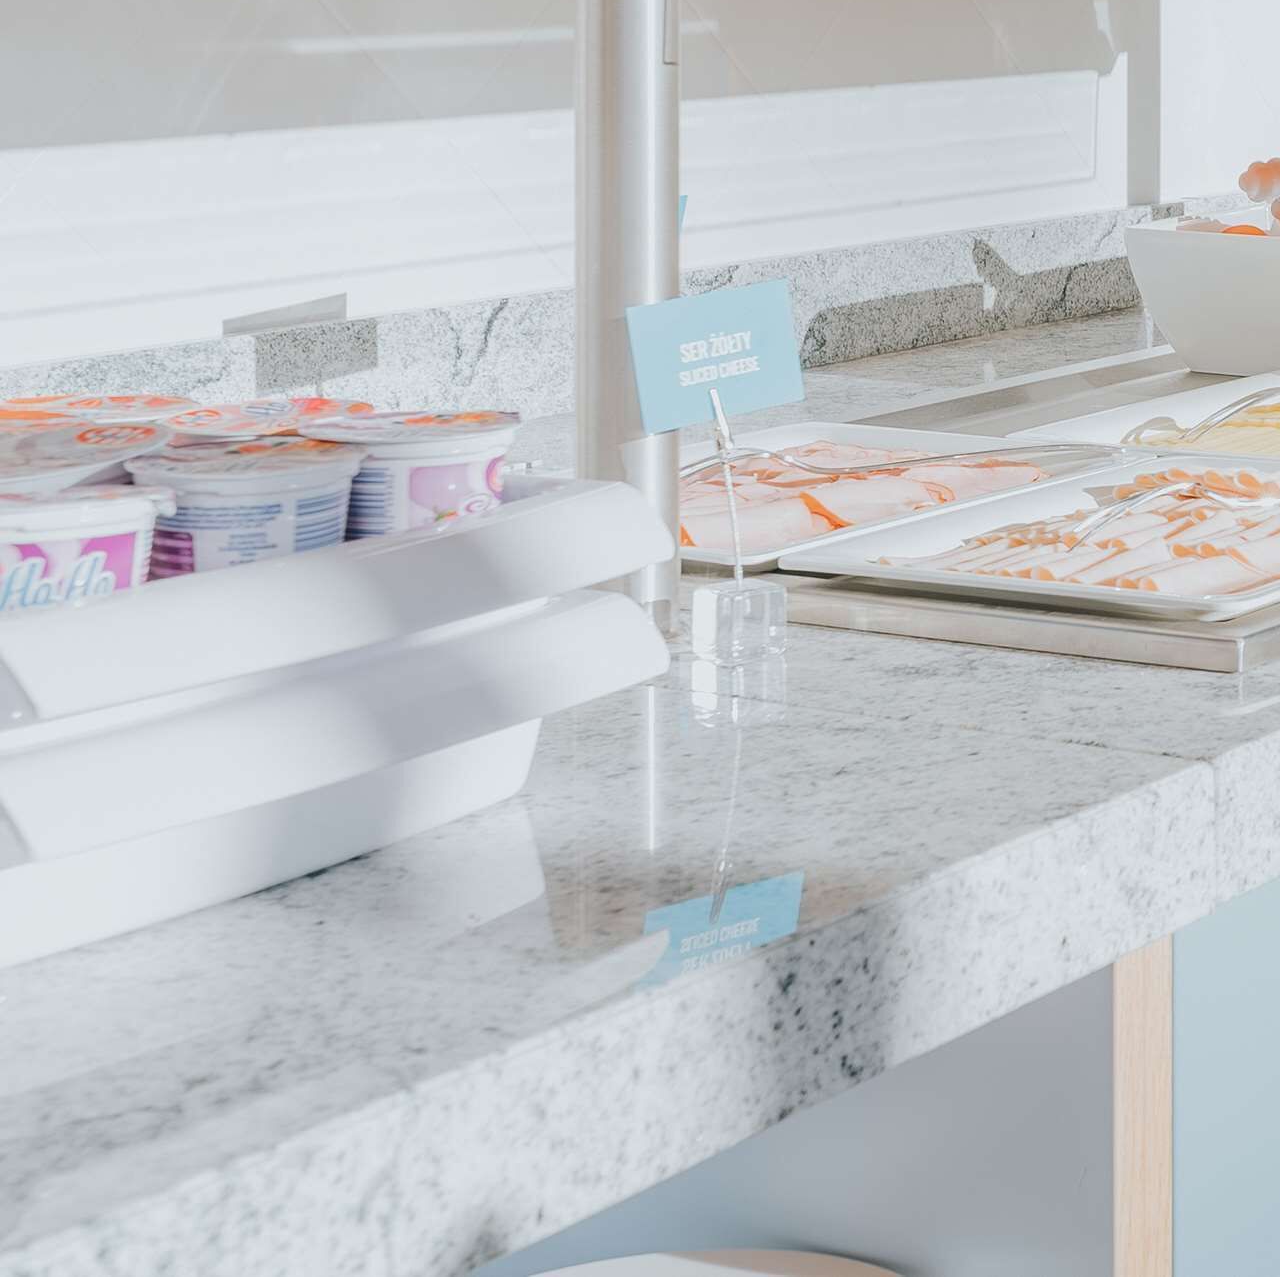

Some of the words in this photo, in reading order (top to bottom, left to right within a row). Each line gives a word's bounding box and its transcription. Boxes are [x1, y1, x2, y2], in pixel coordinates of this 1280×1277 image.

[680, 340, 708, 363] SER
[709, 331, 751, 357] ŻÓŁTY
[680, 365, 718, 387] SLICED
[719, 356, 760, 378] CHEESE
